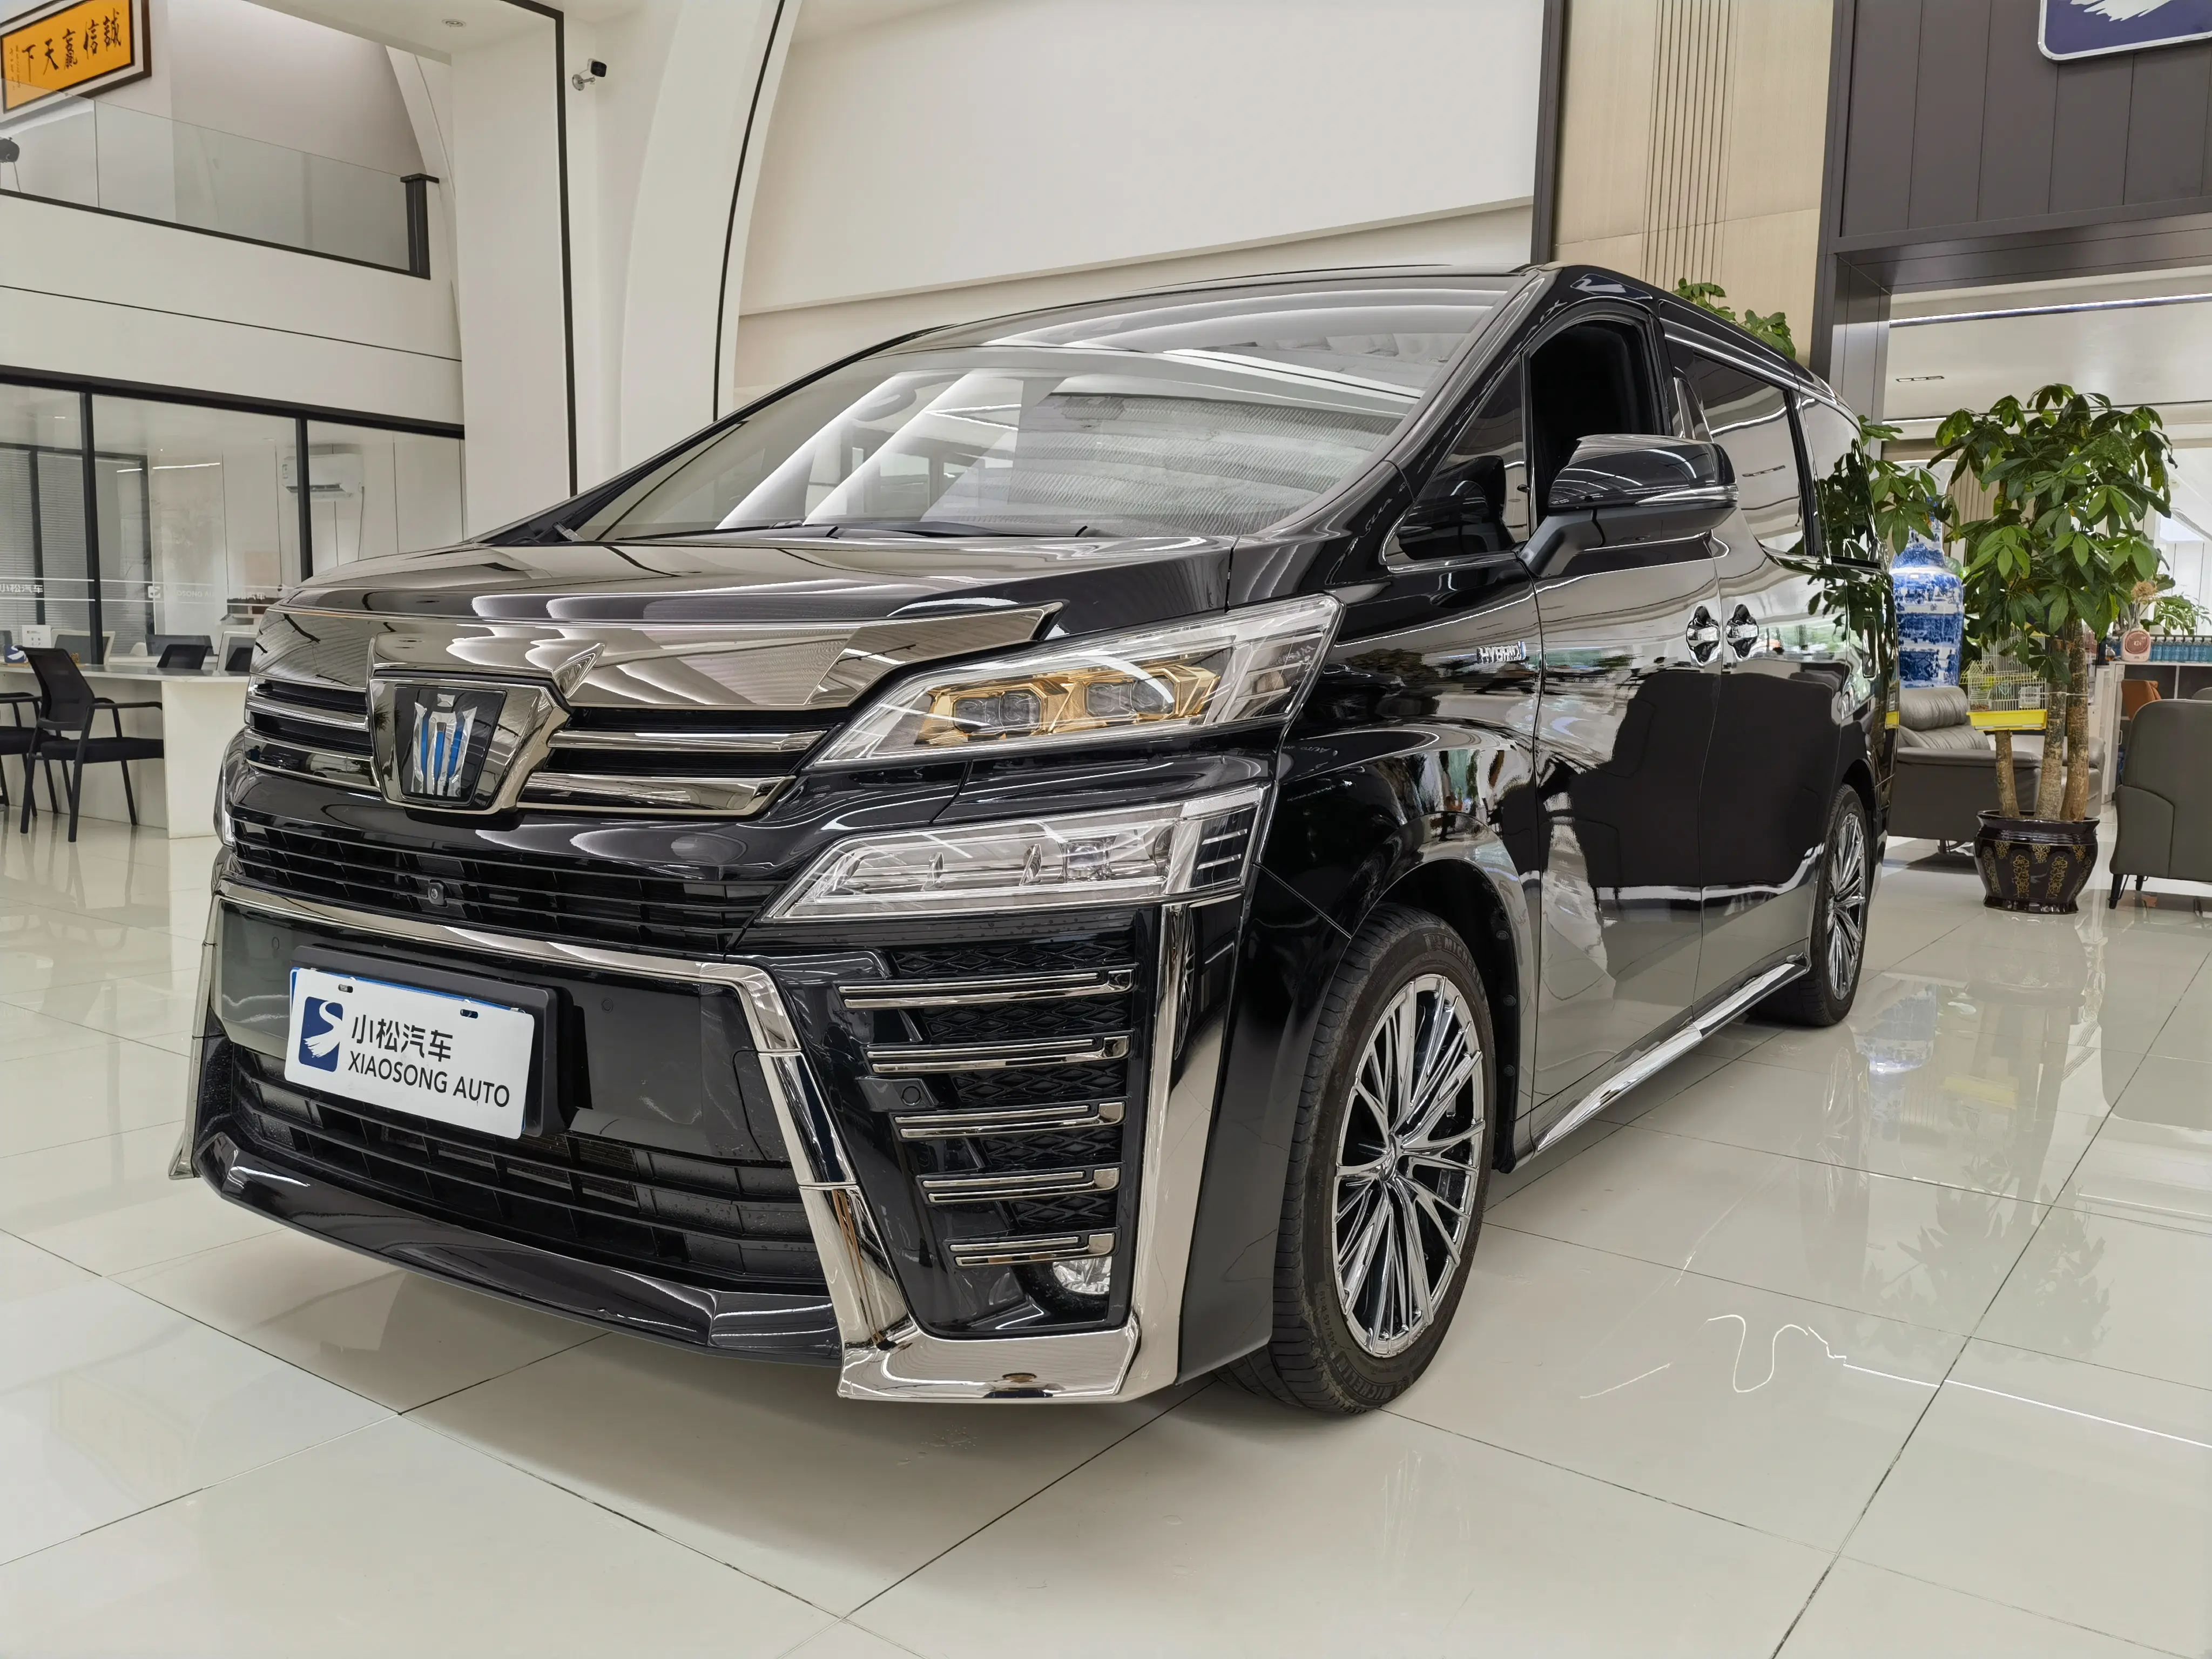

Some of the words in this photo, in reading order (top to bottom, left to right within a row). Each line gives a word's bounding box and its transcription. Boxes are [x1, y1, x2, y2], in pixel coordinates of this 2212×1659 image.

[0, 583, 43, 594] 小松汽车
[1478, 643, 1523, 664] HYBRID
[1444, 937, 1485, 997] MICHELIN
[351, 1015, 453, 1062] 小松汽车
[348, 1050, 448, 1093] XIAOSONG
[453, 1076, 510, 1108] AUTO
[1337, 1360, 1394, 1399] MICHELIN
